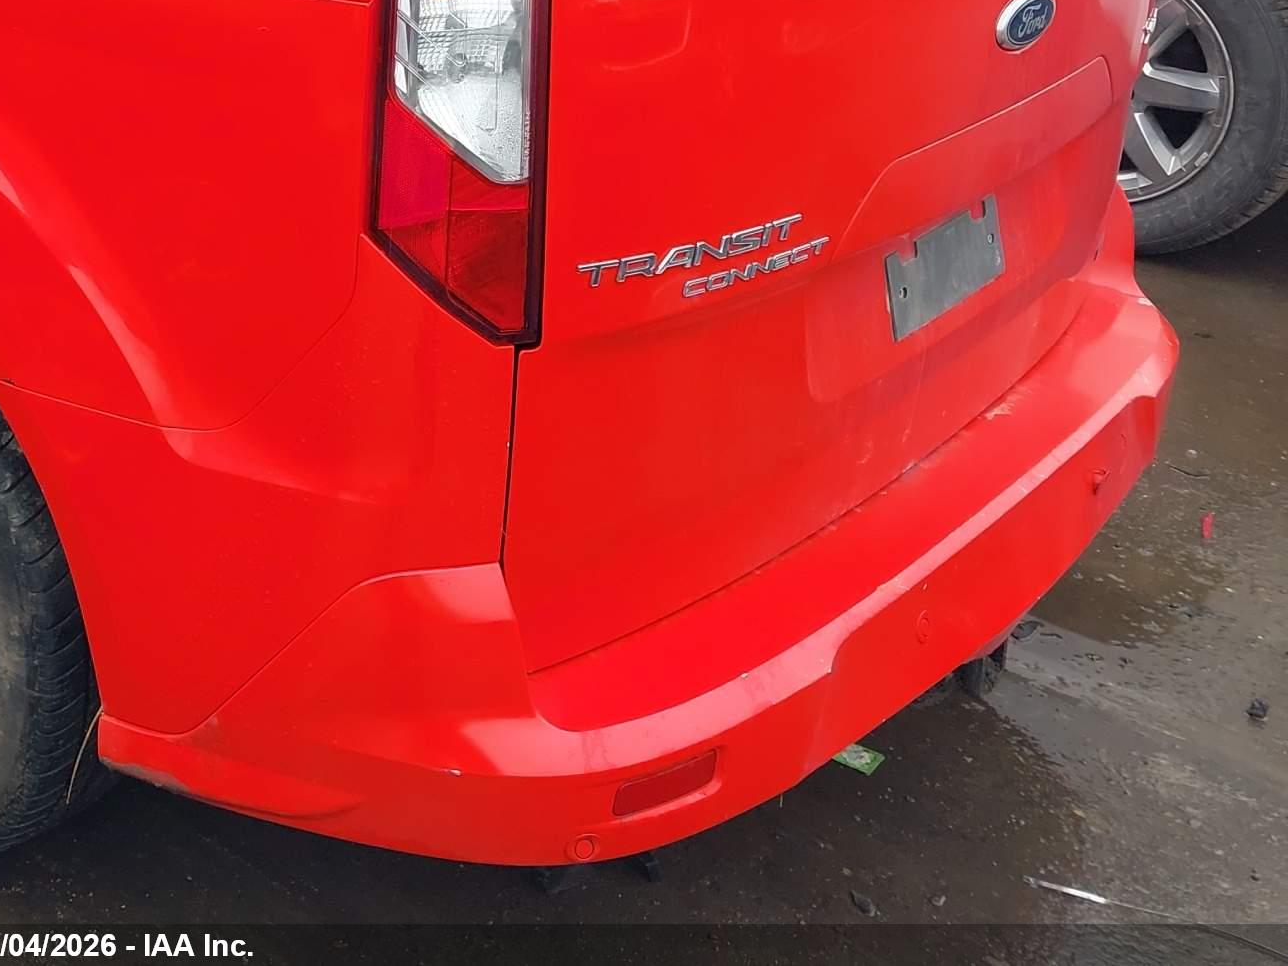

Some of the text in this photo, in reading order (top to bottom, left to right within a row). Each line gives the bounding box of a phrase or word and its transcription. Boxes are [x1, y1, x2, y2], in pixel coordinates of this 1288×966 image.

[1017, 2, 1049, 39] Ford
[577, 213, 803, 288] TRANSIT
[682, 236, 830, 299] CONNECT
